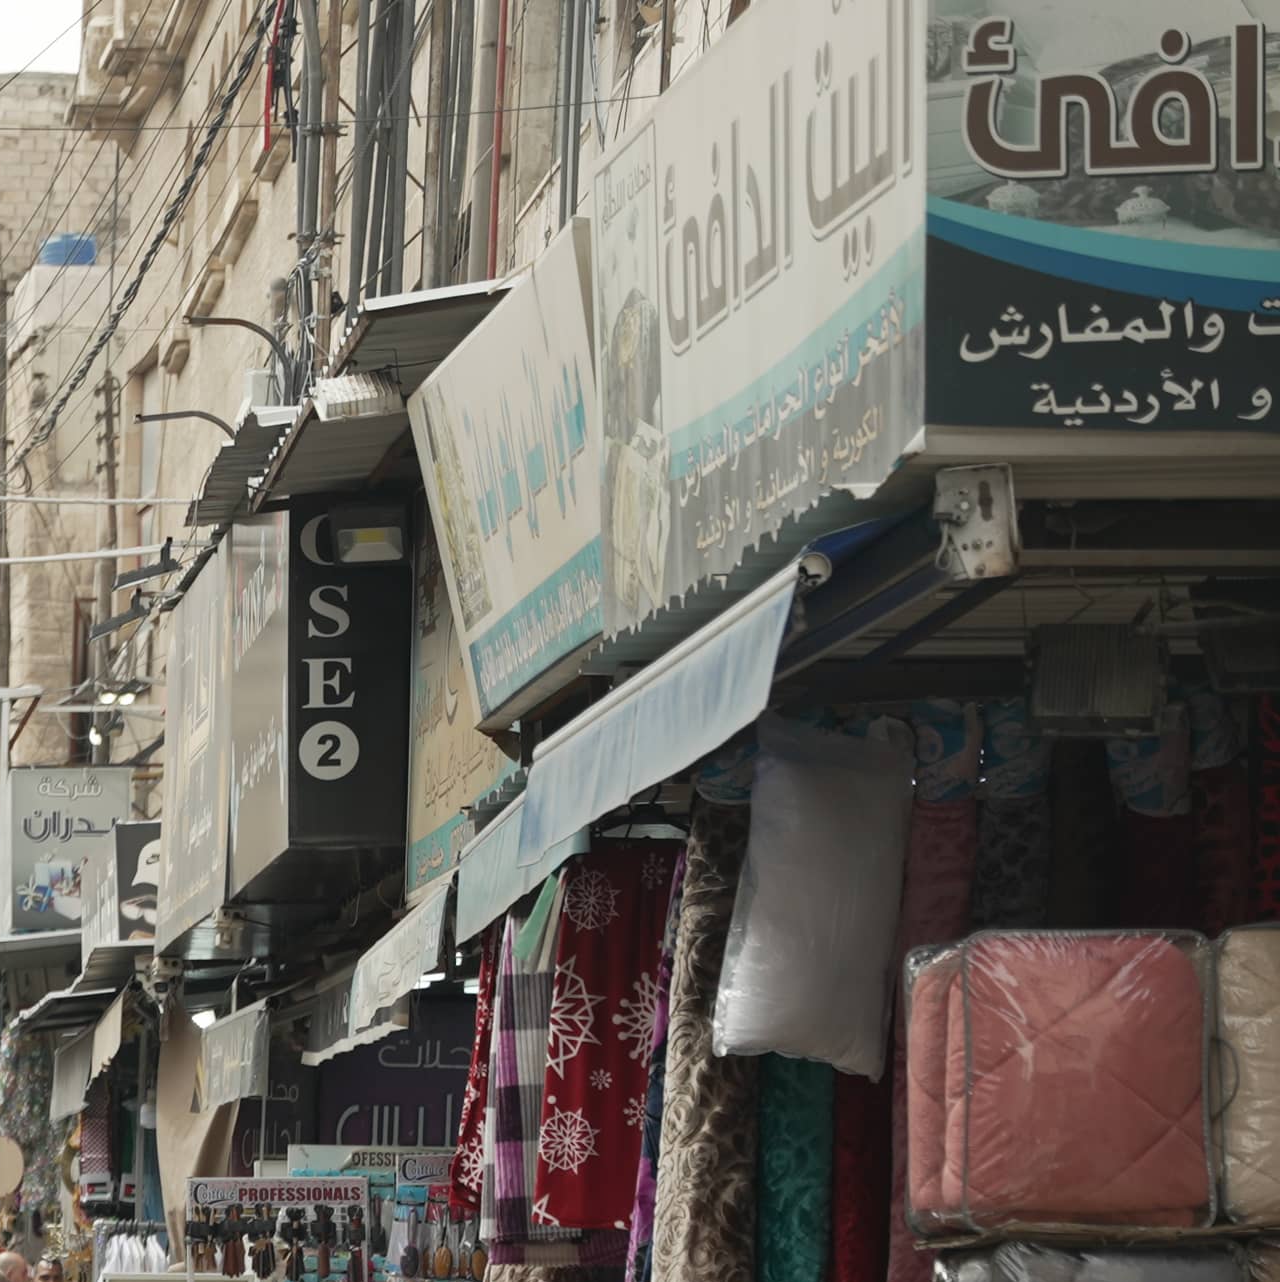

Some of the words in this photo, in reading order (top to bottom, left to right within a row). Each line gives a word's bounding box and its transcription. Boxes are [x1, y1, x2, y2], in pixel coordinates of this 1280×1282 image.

[962, 15, 1280, 179] افئ
[663, 69, 794, 357] الدافئ
[959, 300, 1226, 363] والمفارش
[814, 328, 850, 421] أنواع
[1030, 367, 1220, 427] الأردنية
[1237, 386, 1273, 420] و
[679, 423, 741, 508] والمفارش
[832, 403, 884, 472] الكورية
[316, 733, 343, 768] 2
[38, 775, 103, 801] شركة
[367, 1039, 463, 1068] حلات
[239, 1186, 362, 1201] PROFESSIONALS
